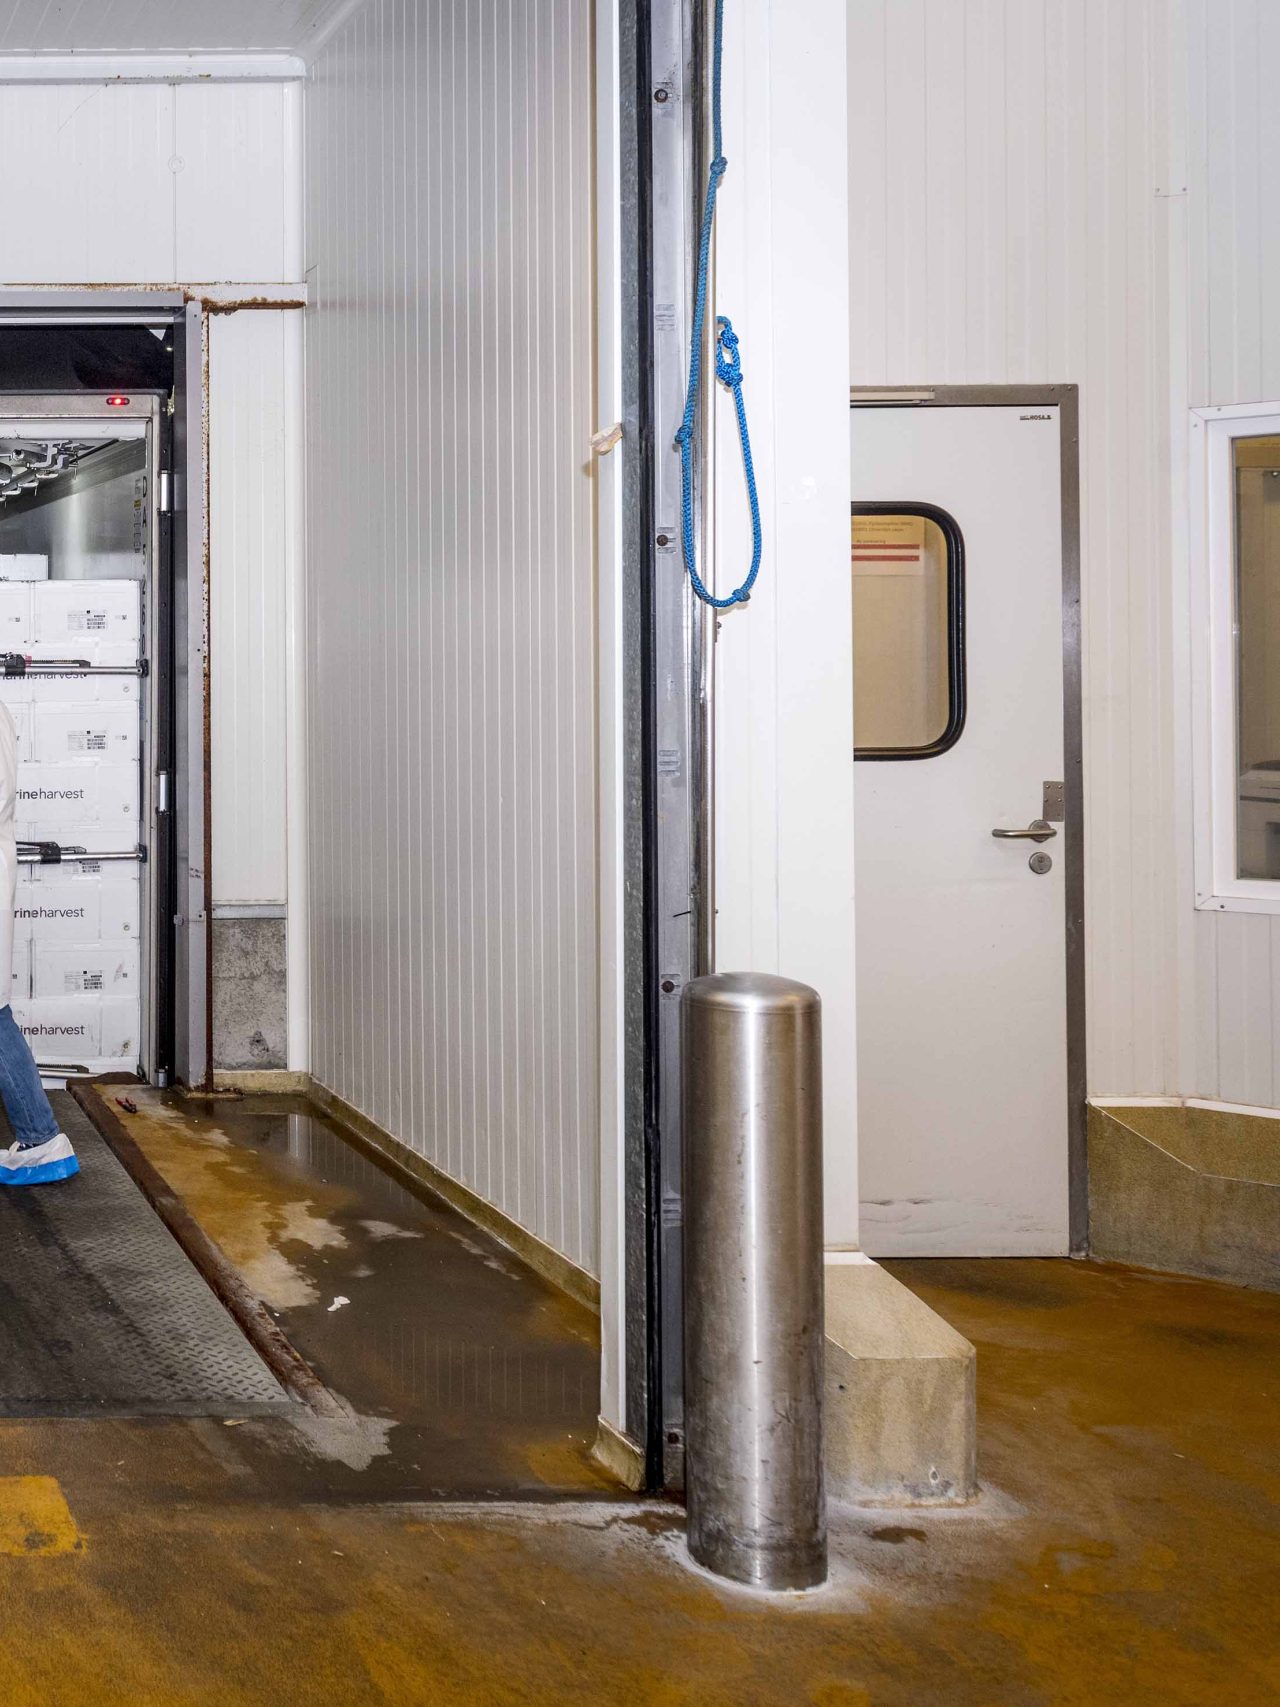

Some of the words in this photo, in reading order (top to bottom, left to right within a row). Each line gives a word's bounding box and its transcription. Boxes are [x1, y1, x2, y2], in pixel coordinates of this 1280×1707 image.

[16, 787, 85, 800] ineharvest
[13, 907, 85, 919] rineharvest
[20, 1023, 86, 1035] ineharvest
